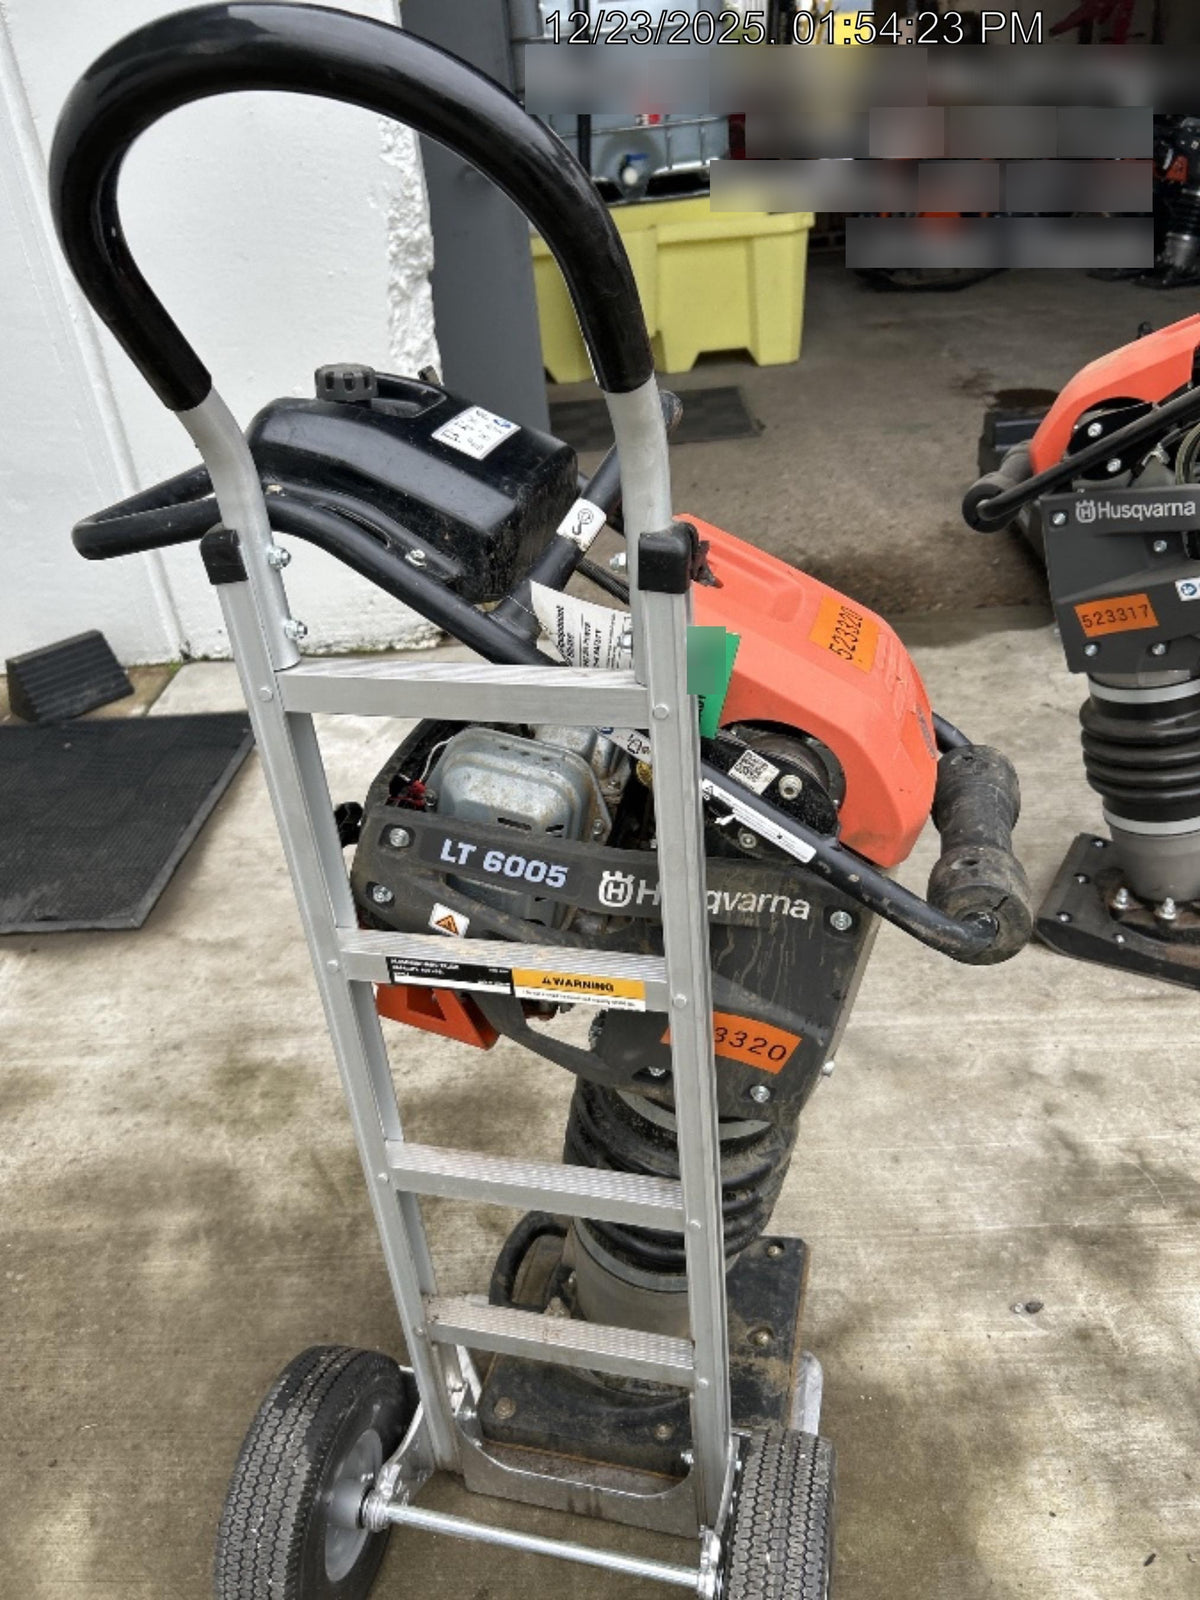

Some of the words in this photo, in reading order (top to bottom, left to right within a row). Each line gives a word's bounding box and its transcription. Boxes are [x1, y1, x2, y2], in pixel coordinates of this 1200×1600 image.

[1097, 501, 1197, 521] Husqvarna
[1081, 604, 1150, 629] 523317
[440, 838, 478, 865] LT
[482, 850, 570, 888] 6005
[635, 878, 811, 921] Hqvarna
[552, 976, 615, 993] WARNING
